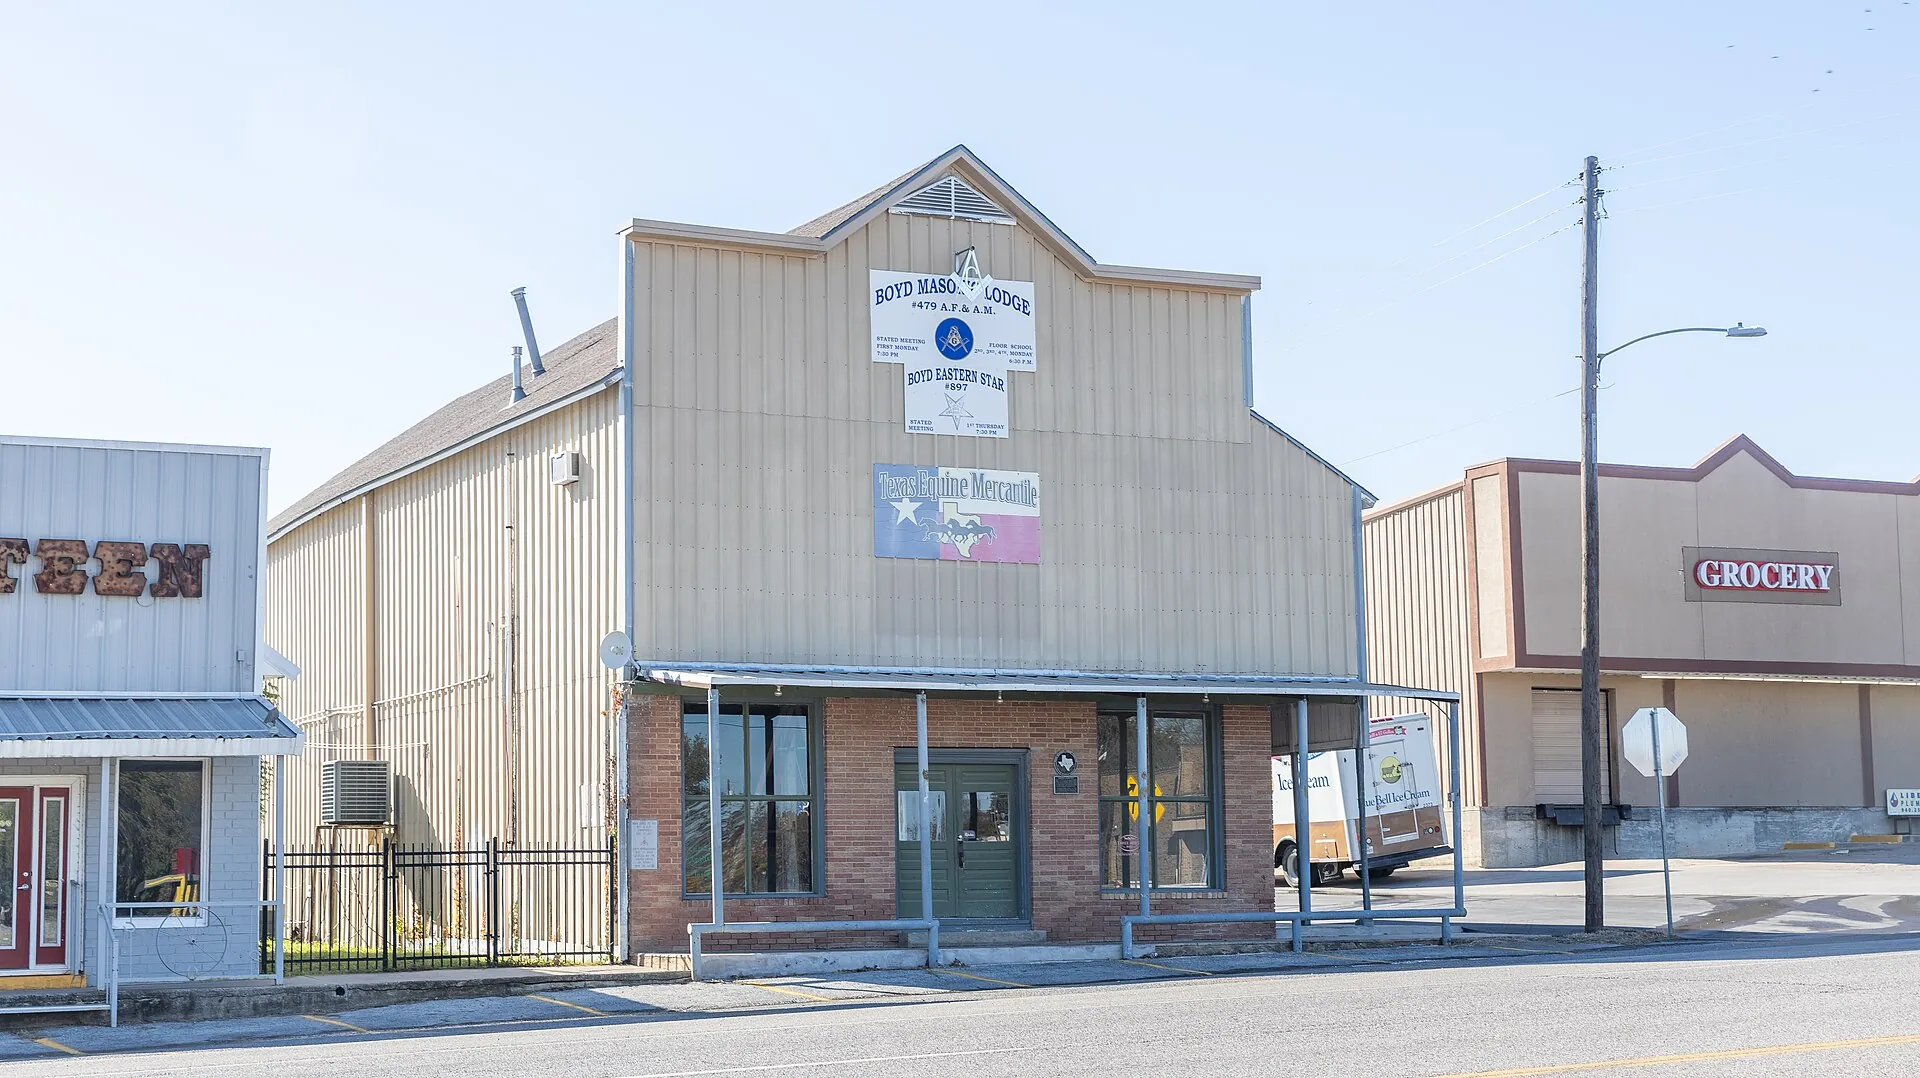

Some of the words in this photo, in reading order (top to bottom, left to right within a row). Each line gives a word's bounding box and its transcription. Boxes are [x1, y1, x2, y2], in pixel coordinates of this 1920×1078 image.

[875, 280, 913, 306] BOYD
[917, 277, 980, 297] MASO
[984, 285, 1031, 316] LODGE
[911, 301, 937, 311] #479
[972, 306, 996, 315] A.M.
[899, 337, 926, 345] MEETING
[907, 368, 933, 386] BOYD
[935, 367, 978, 383] EASTERN
[980, 372, 1005, 392] STAR
[944, 382, 968, 392] #897
[879, 471, 916, 499] Texas
[917, 469, 969, 501] Equine
[969, 471, 1037, 508] Mercantile
[1697, 560, 1834, 590] GROCERY
[1277, 773, 1294, 791] Ice
[1375, 792, 1392, 806] Bell
[1391, 792, 1404, 803] Ice
[1403, 789, 1431, 801] Cream
